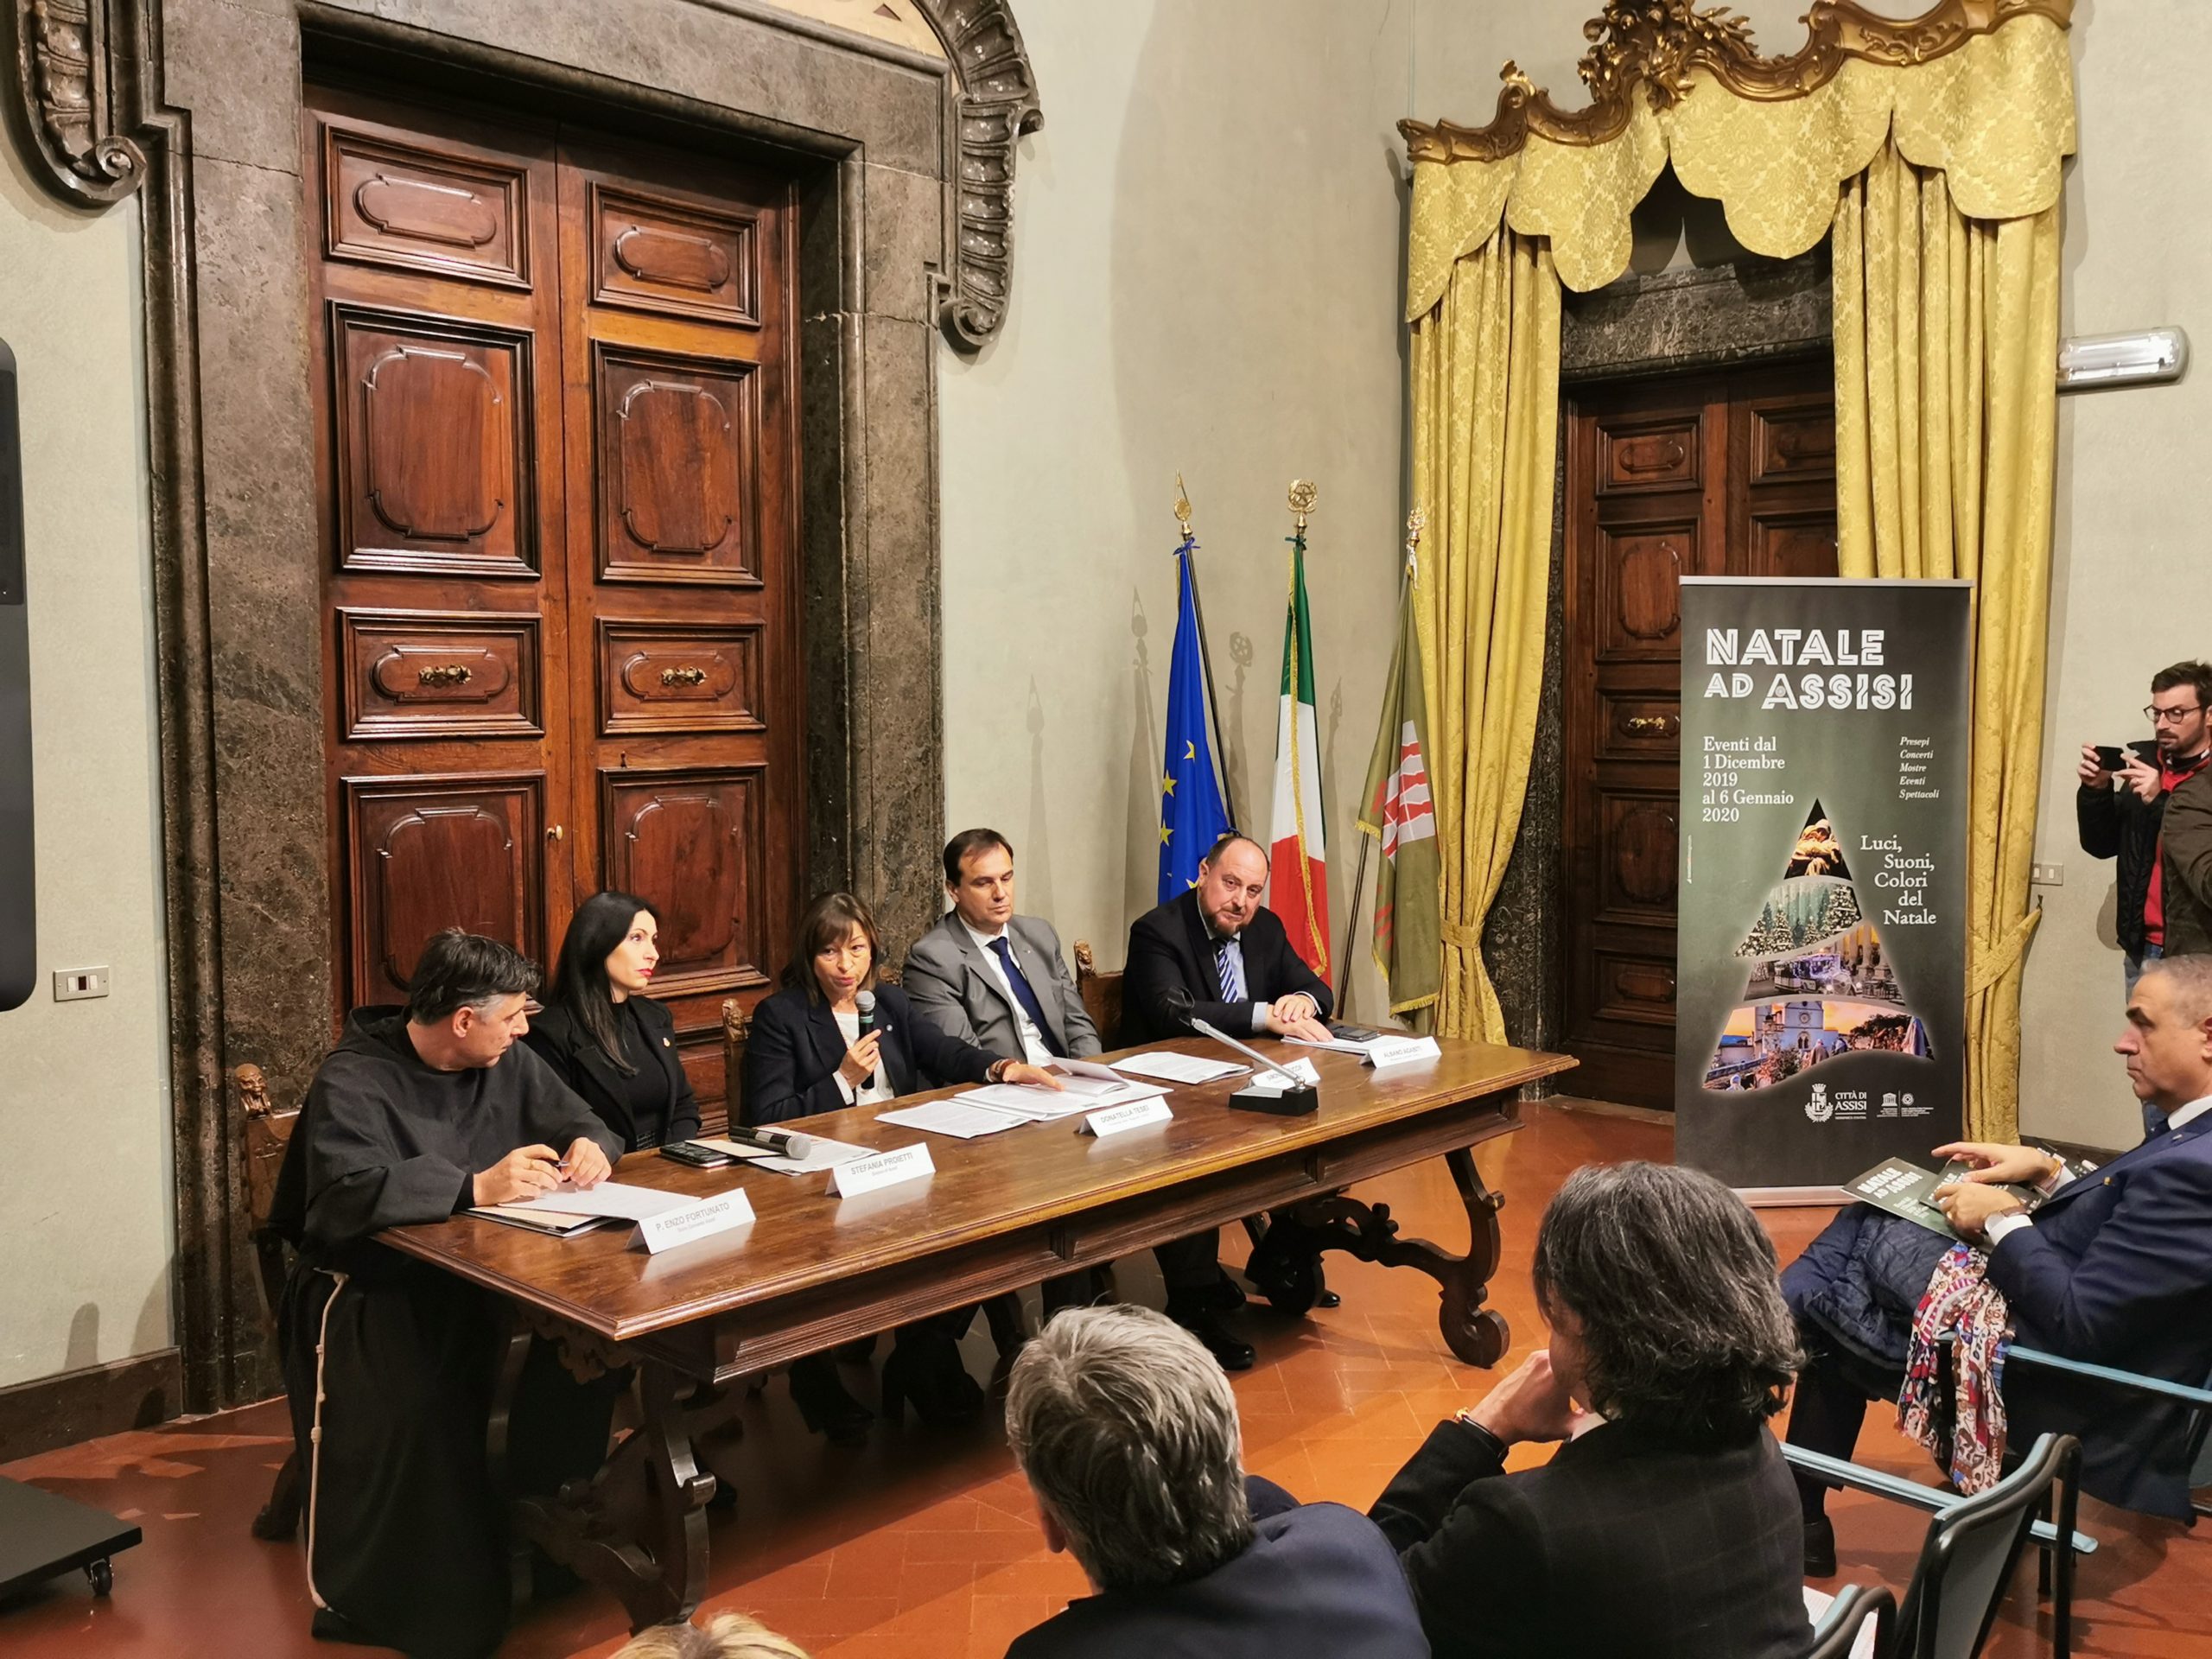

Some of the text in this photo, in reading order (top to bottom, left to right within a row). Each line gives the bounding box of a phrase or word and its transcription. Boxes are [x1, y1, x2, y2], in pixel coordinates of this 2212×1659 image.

[1706, 628, 1885, 666] NATALE
[1703, 672, 1913, 710] AD ASSISI
[1703, 736, 1777, 752] Eventi dal
[1899, 736, 1930, 748] Presepi
[1703, 753, 1786, 769] 1 Dicembre
[1899, 749, 1934, 760] Concerti
[1899, 762, 1927, 772] Mostre
[1702, 772, 1738, 787] 2019
[1899, 776, 1926, 785] Eventi
[1702, 789, 1795, 804] al 6 Gennaio
[1898, 788, 1940, 801] Spettacoli
[1702, 807, 1740, 823] 2020
[1859, 834, 1903, 853] Luci,
[1884, 853, 1935, 872] Suoni,
[1874, 870, 1928, 888] Colori
[1897, 889, 1923, 906] del
[1883, 908, 1937, 925] Natale
[1834, 1090, 1867, 1100] CITTÀ DI
[1834, 1100, 1867, 1111] ASSISI
[850, 1160, 884, 1175] STEFANIA
[884, 1152, 913, 1167] PROIETTI
[655, 1223, 664, 1231] P.
[664, 1216, 685, 1229] ENZO
[685, 1202, 731, 1223] FORTUNATO
